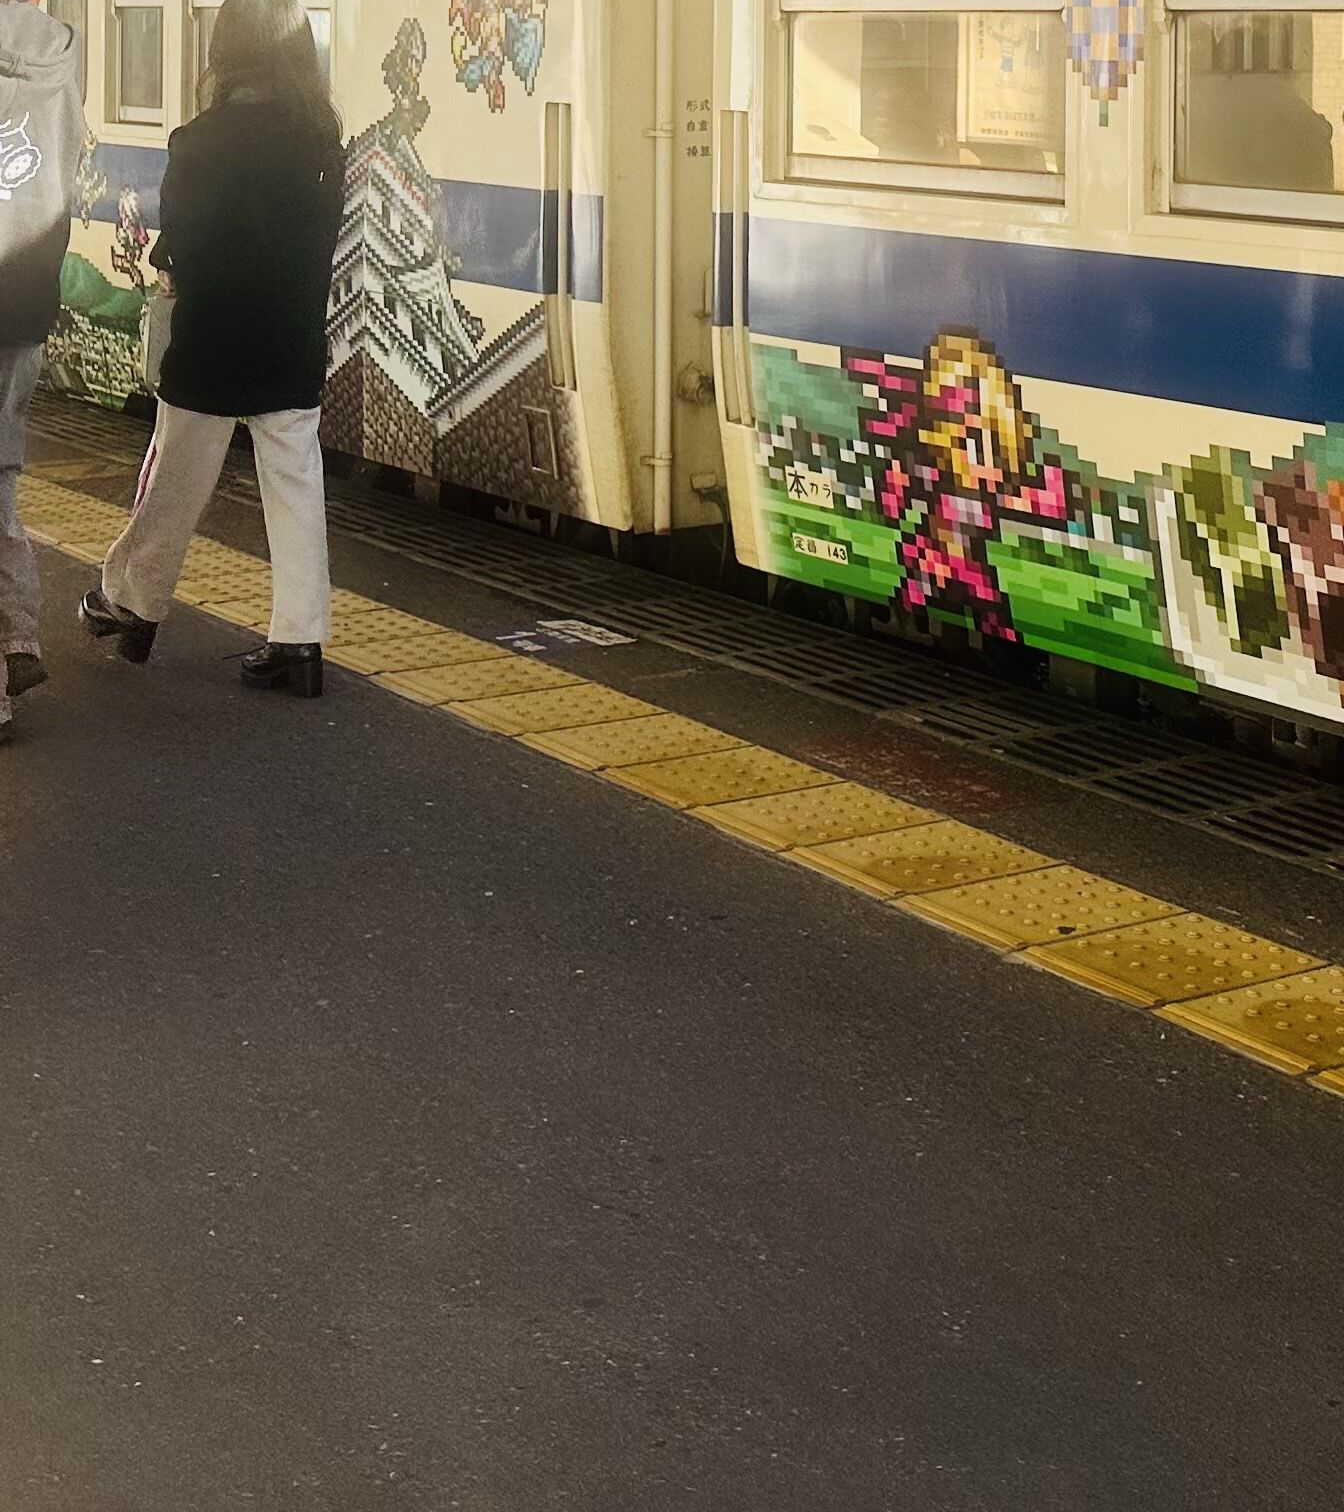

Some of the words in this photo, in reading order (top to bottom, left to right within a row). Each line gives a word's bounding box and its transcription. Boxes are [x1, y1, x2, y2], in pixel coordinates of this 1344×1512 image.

[788, 470, 831, 499] 本カラ
[828, 544, 846, 561] 143
